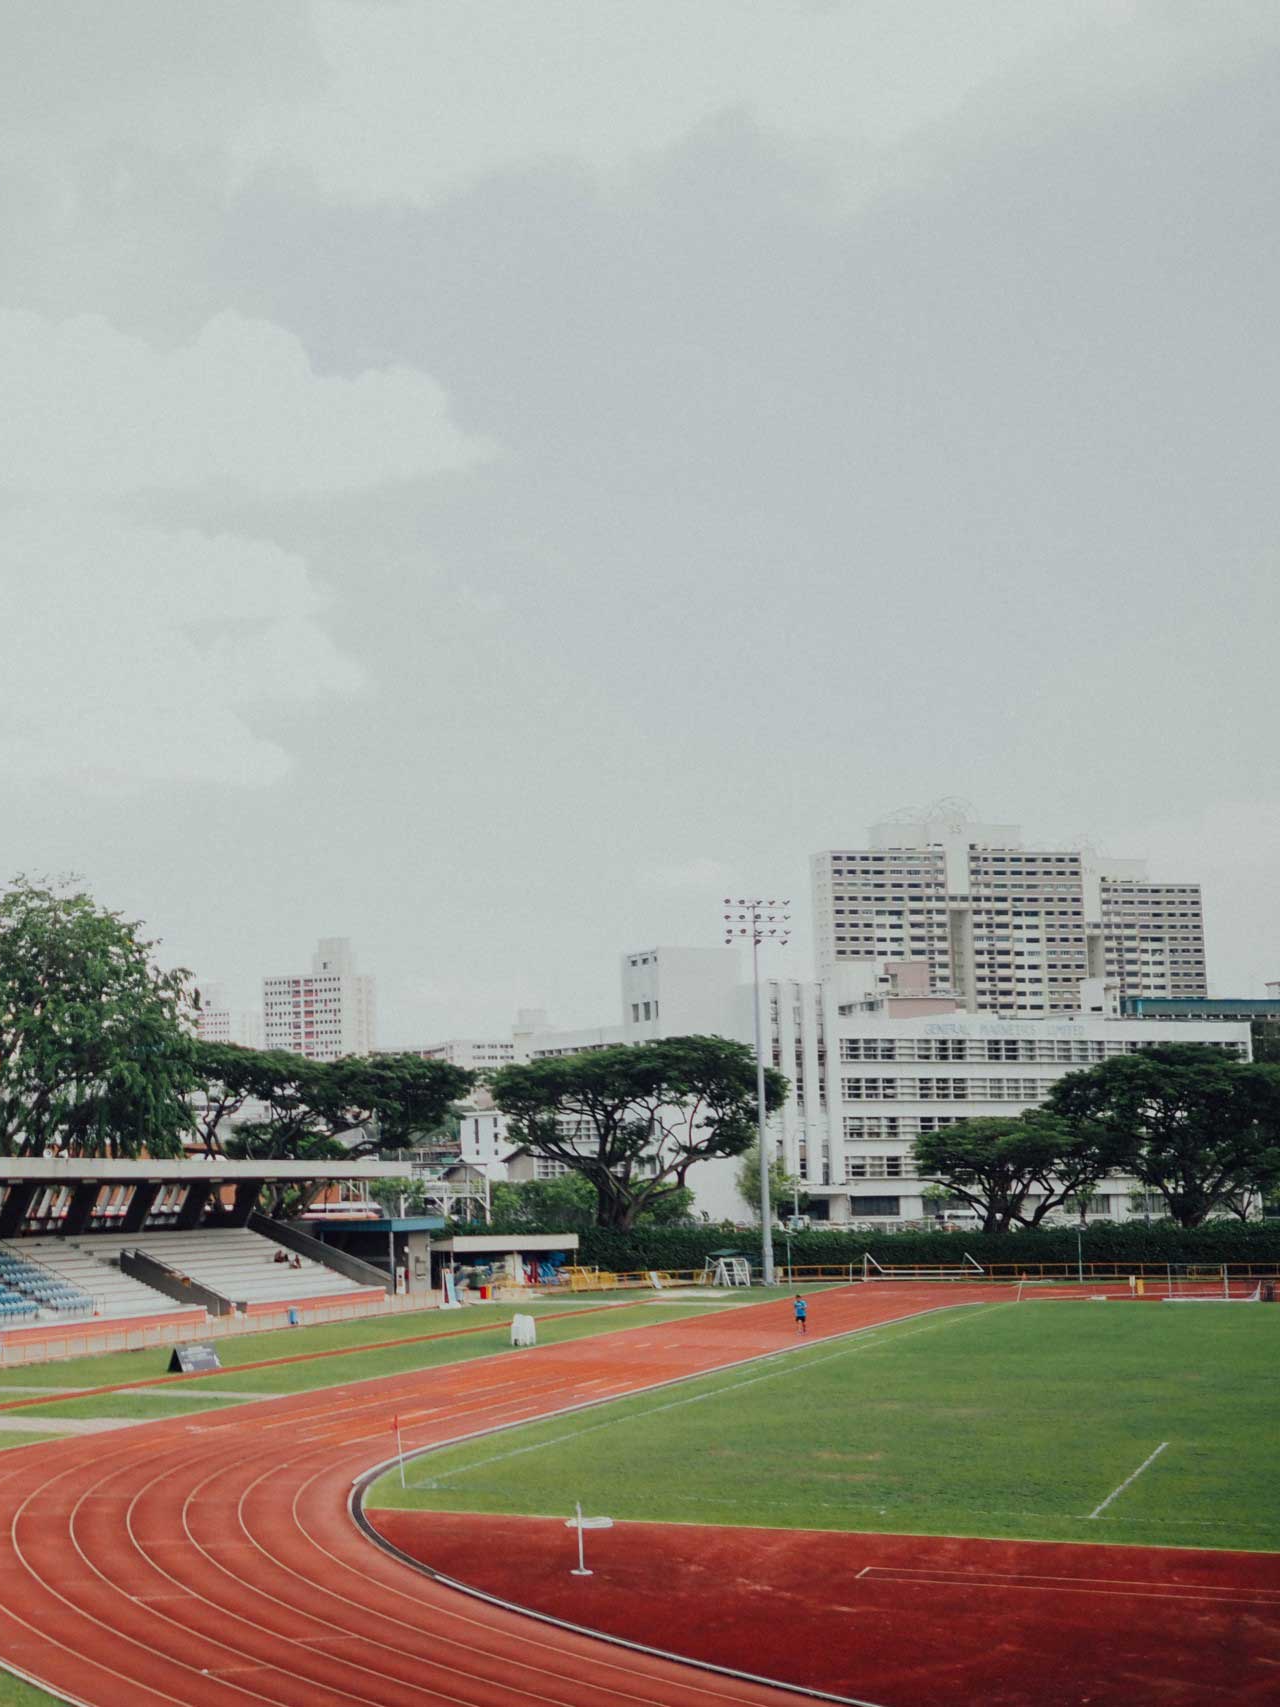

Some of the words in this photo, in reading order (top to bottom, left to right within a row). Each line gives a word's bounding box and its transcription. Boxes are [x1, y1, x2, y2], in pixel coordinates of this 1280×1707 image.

[924, 1023, 970, 1036] GENERAL
[979, 1023, 1037, 1037] MAGNETICS
[1046, 1024, 1085, 1037] LIMITED
